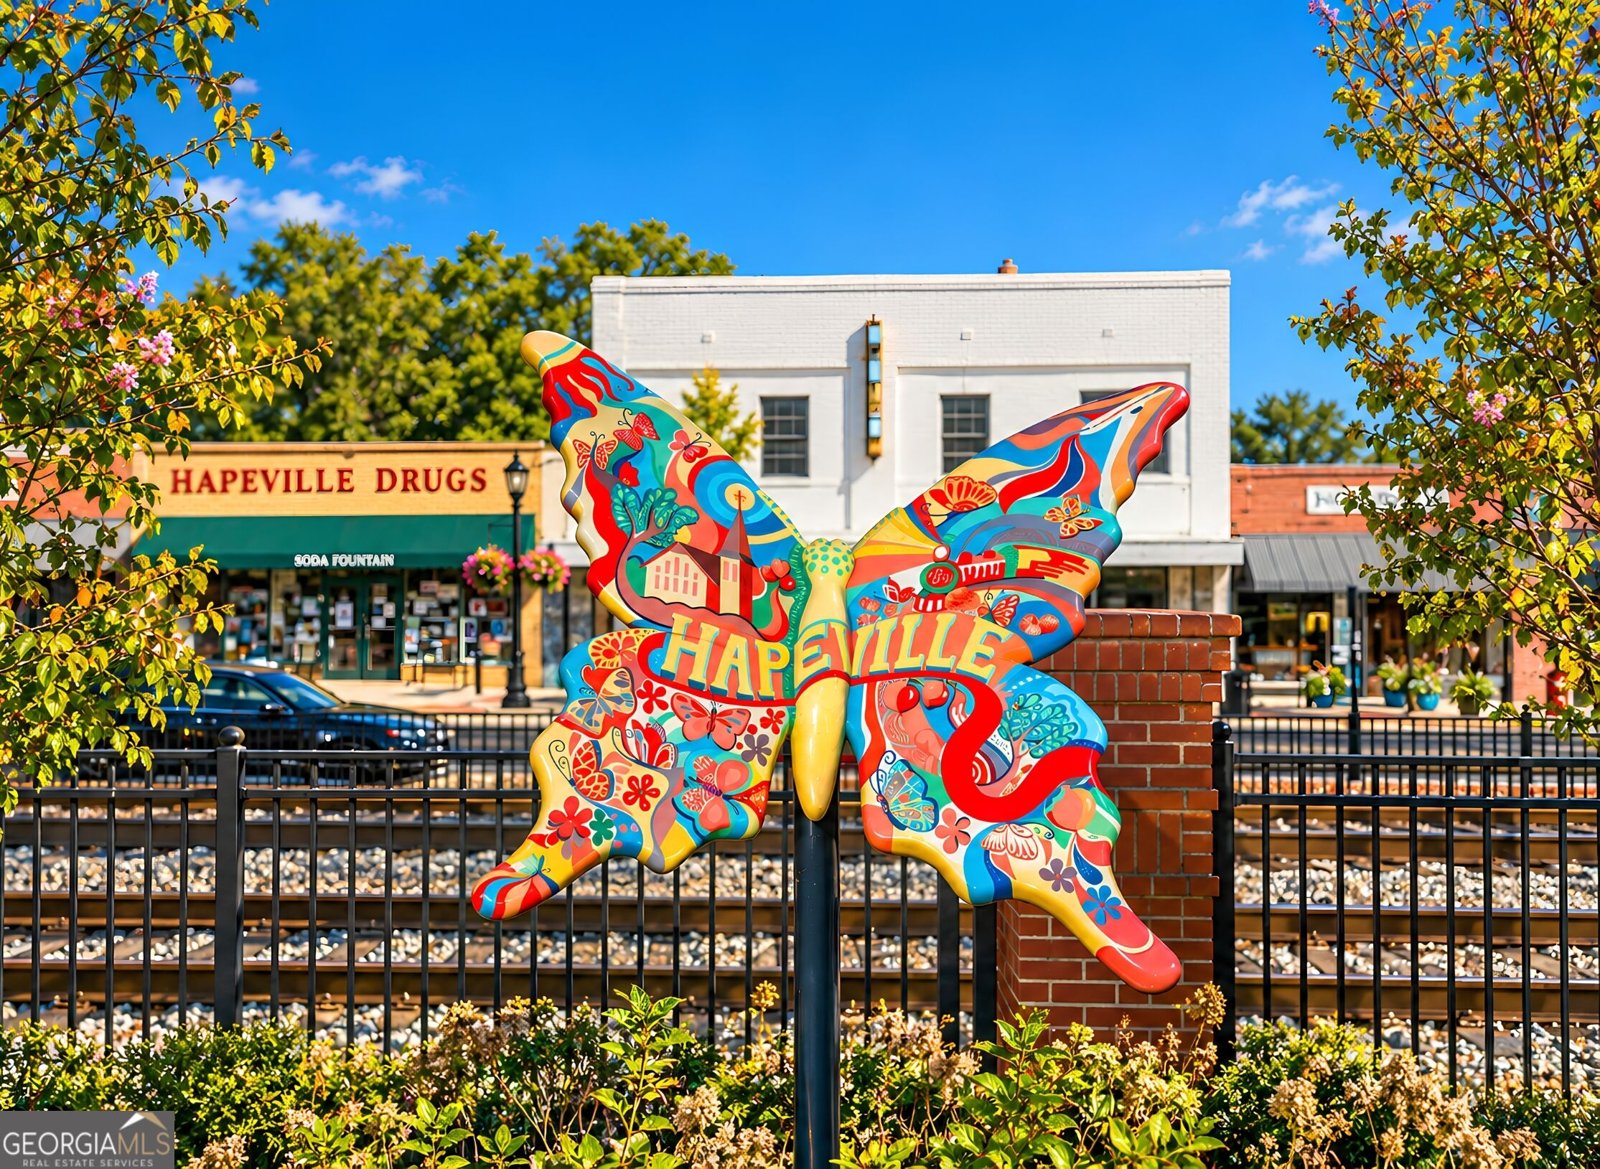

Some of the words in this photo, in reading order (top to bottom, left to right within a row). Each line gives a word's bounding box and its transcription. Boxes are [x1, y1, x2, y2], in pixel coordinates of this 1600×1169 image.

[170, 467, 355, 494] HAPEVILLE
[375, 467, 487, 493] DRUGS
[294, 554, 329, 567] SODA
[331, 554, 395, 567] FOUNTAIN
[660, 612, 1014, 701] HAPEVILLE
